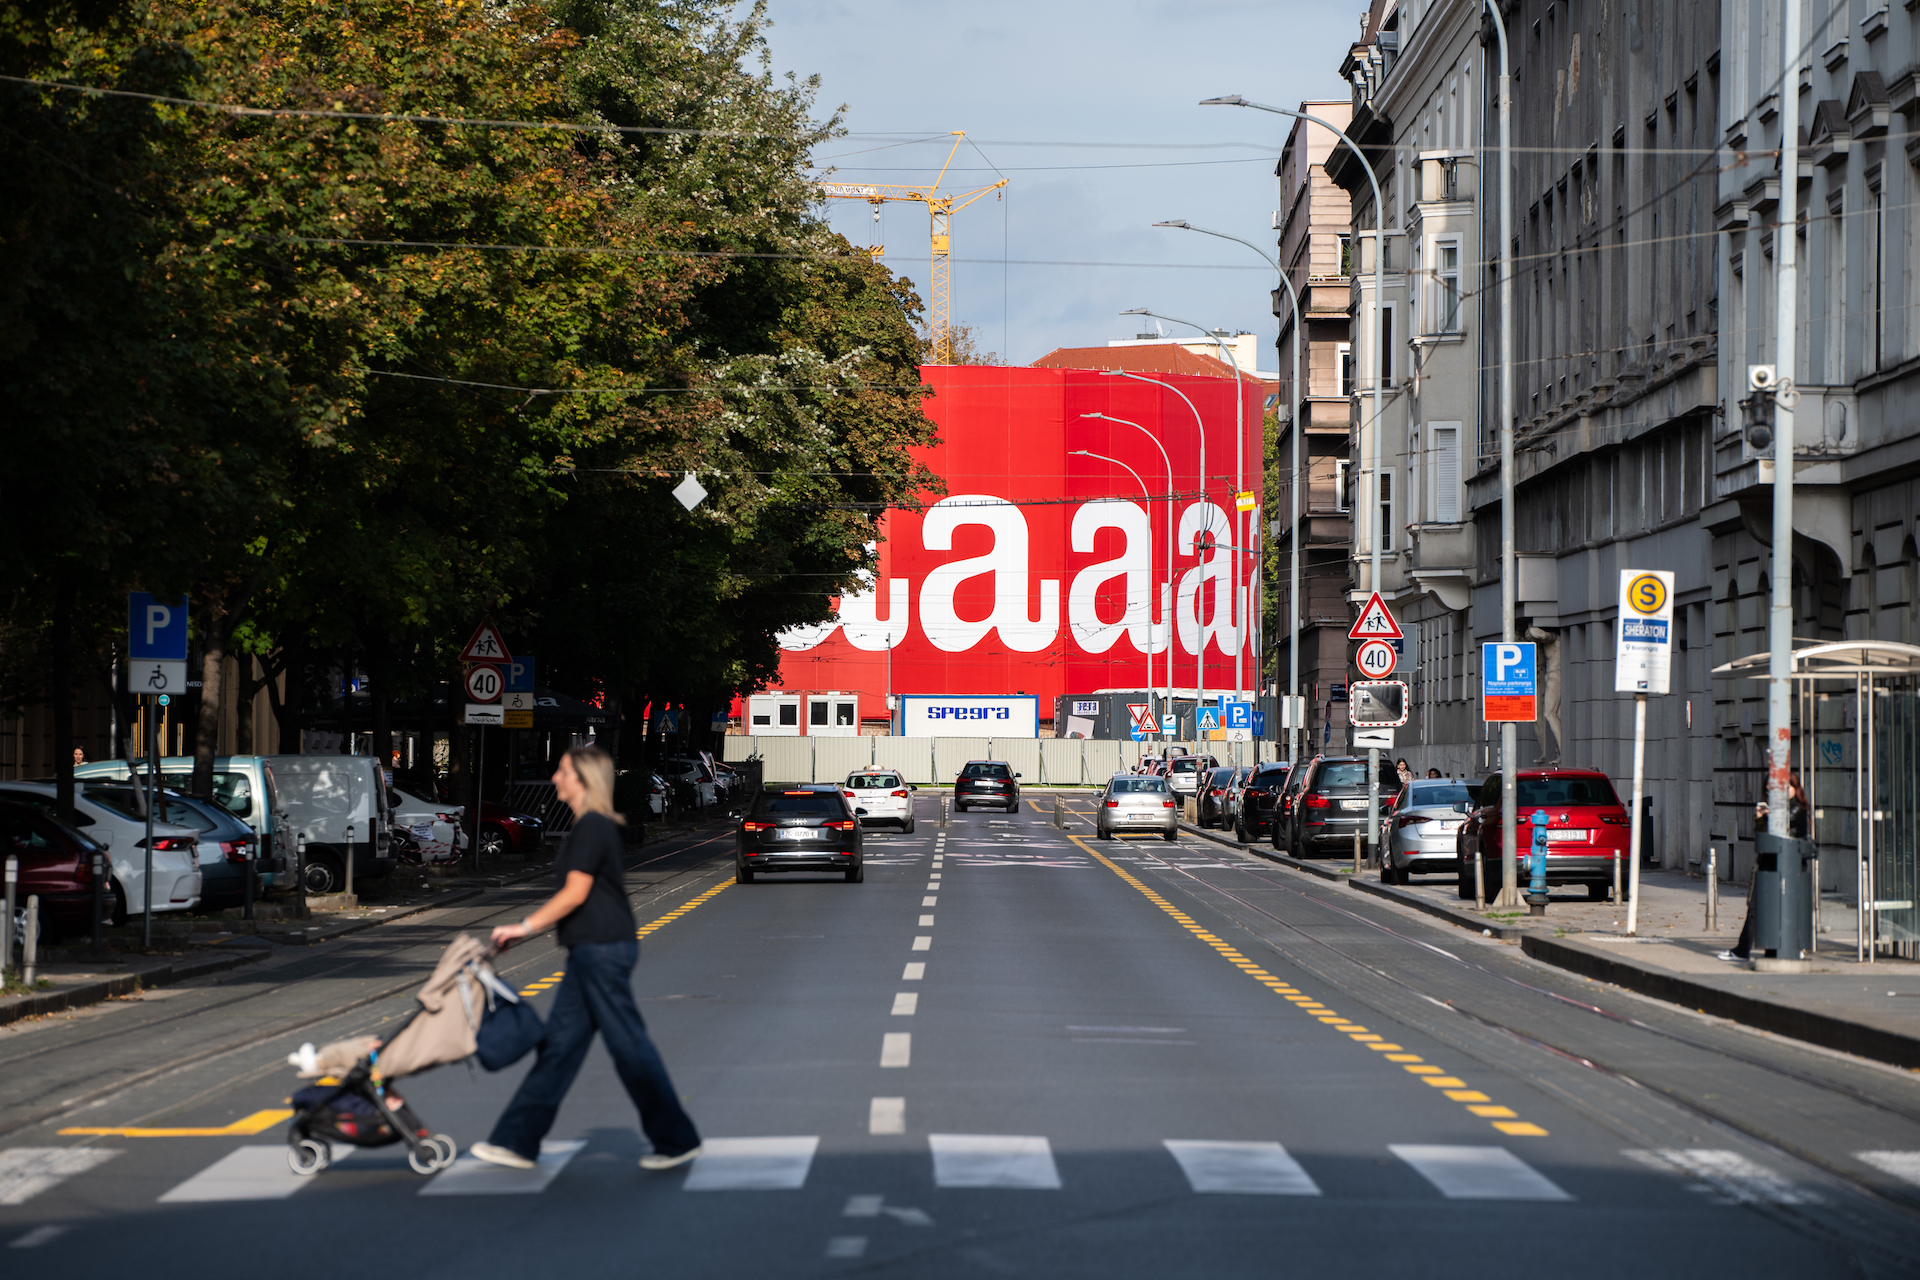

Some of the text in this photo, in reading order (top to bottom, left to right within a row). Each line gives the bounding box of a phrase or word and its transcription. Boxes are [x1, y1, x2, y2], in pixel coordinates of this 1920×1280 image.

[1640, 584, 1656, 606] S
[146, 605, 171, 645] P
[1624, 624, 1666, 638] SHERATON
[1364, 650, 1387, 668] 40
[1496, 645, 1522, 681] P
[473, 674, 496, 694] 40
[510, 663, 525, 685] P
[1233, 706, 1244, 724] P
